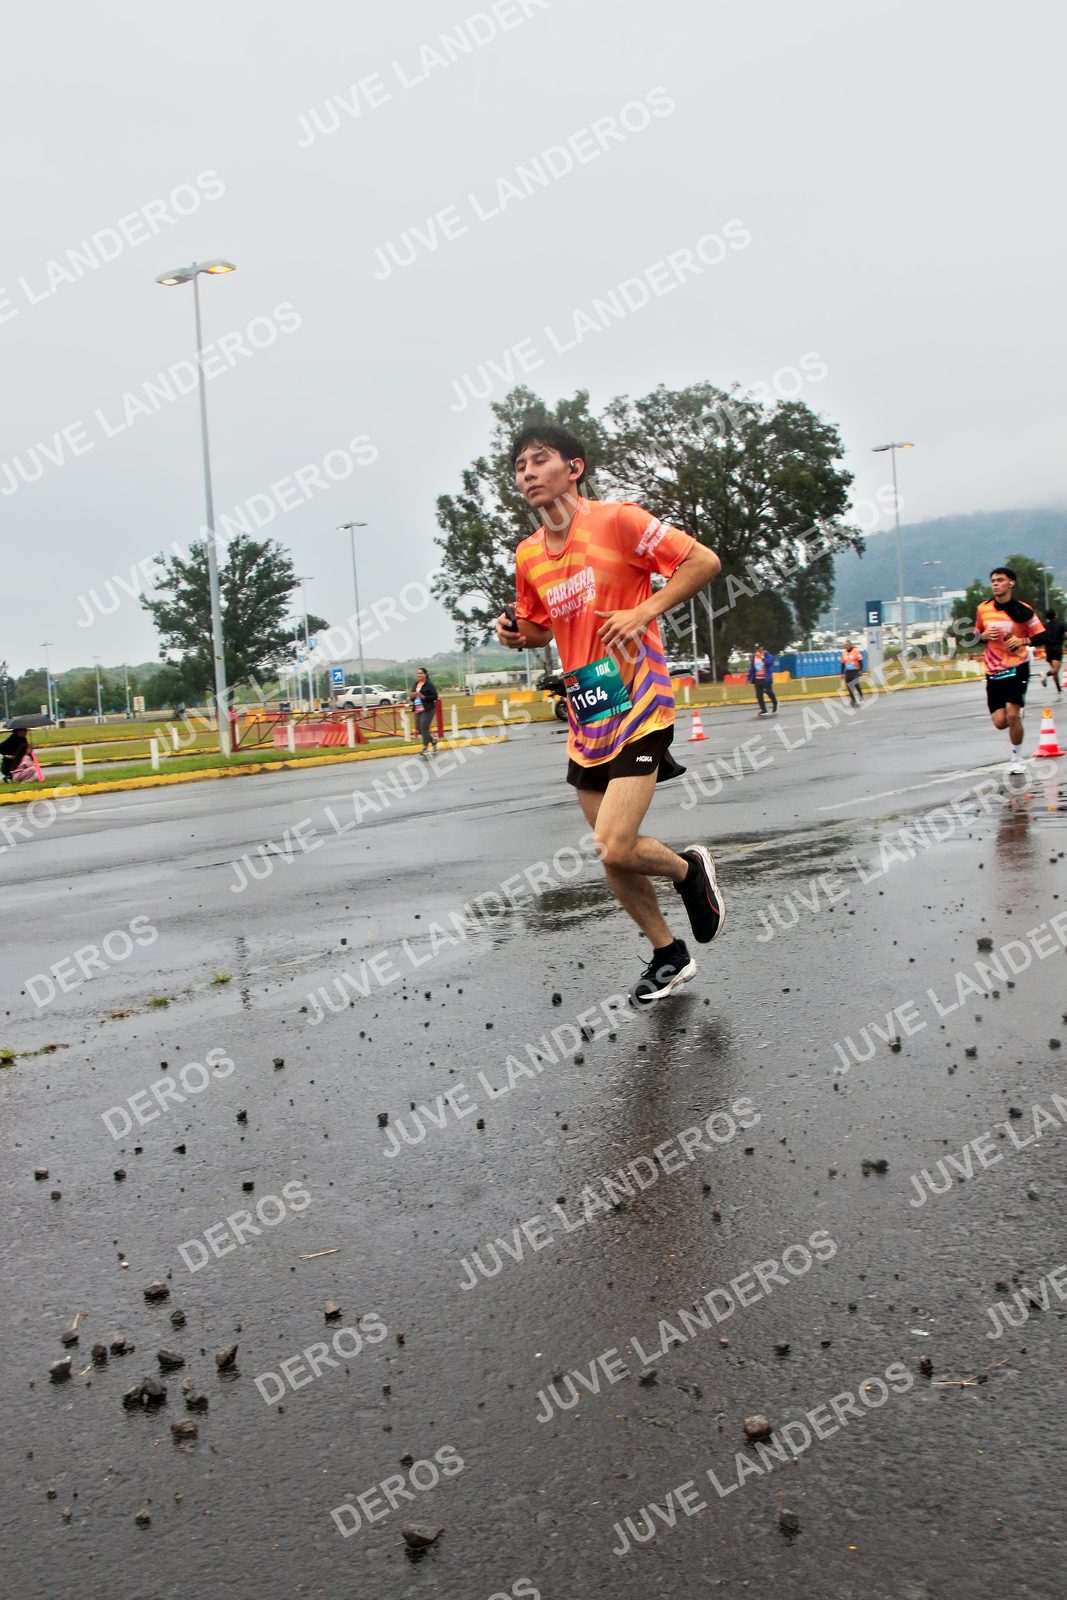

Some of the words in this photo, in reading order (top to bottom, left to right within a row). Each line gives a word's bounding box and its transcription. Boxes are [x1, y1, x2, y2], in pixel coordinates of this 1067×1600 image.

[546, 566, 596, 606] CARRERA
[869, 611, 878, 623] E
[595, 662, 611, 676] 10K
[572, 686, 608, 710] 1164
[636, 755, 653, 763] HOKA
